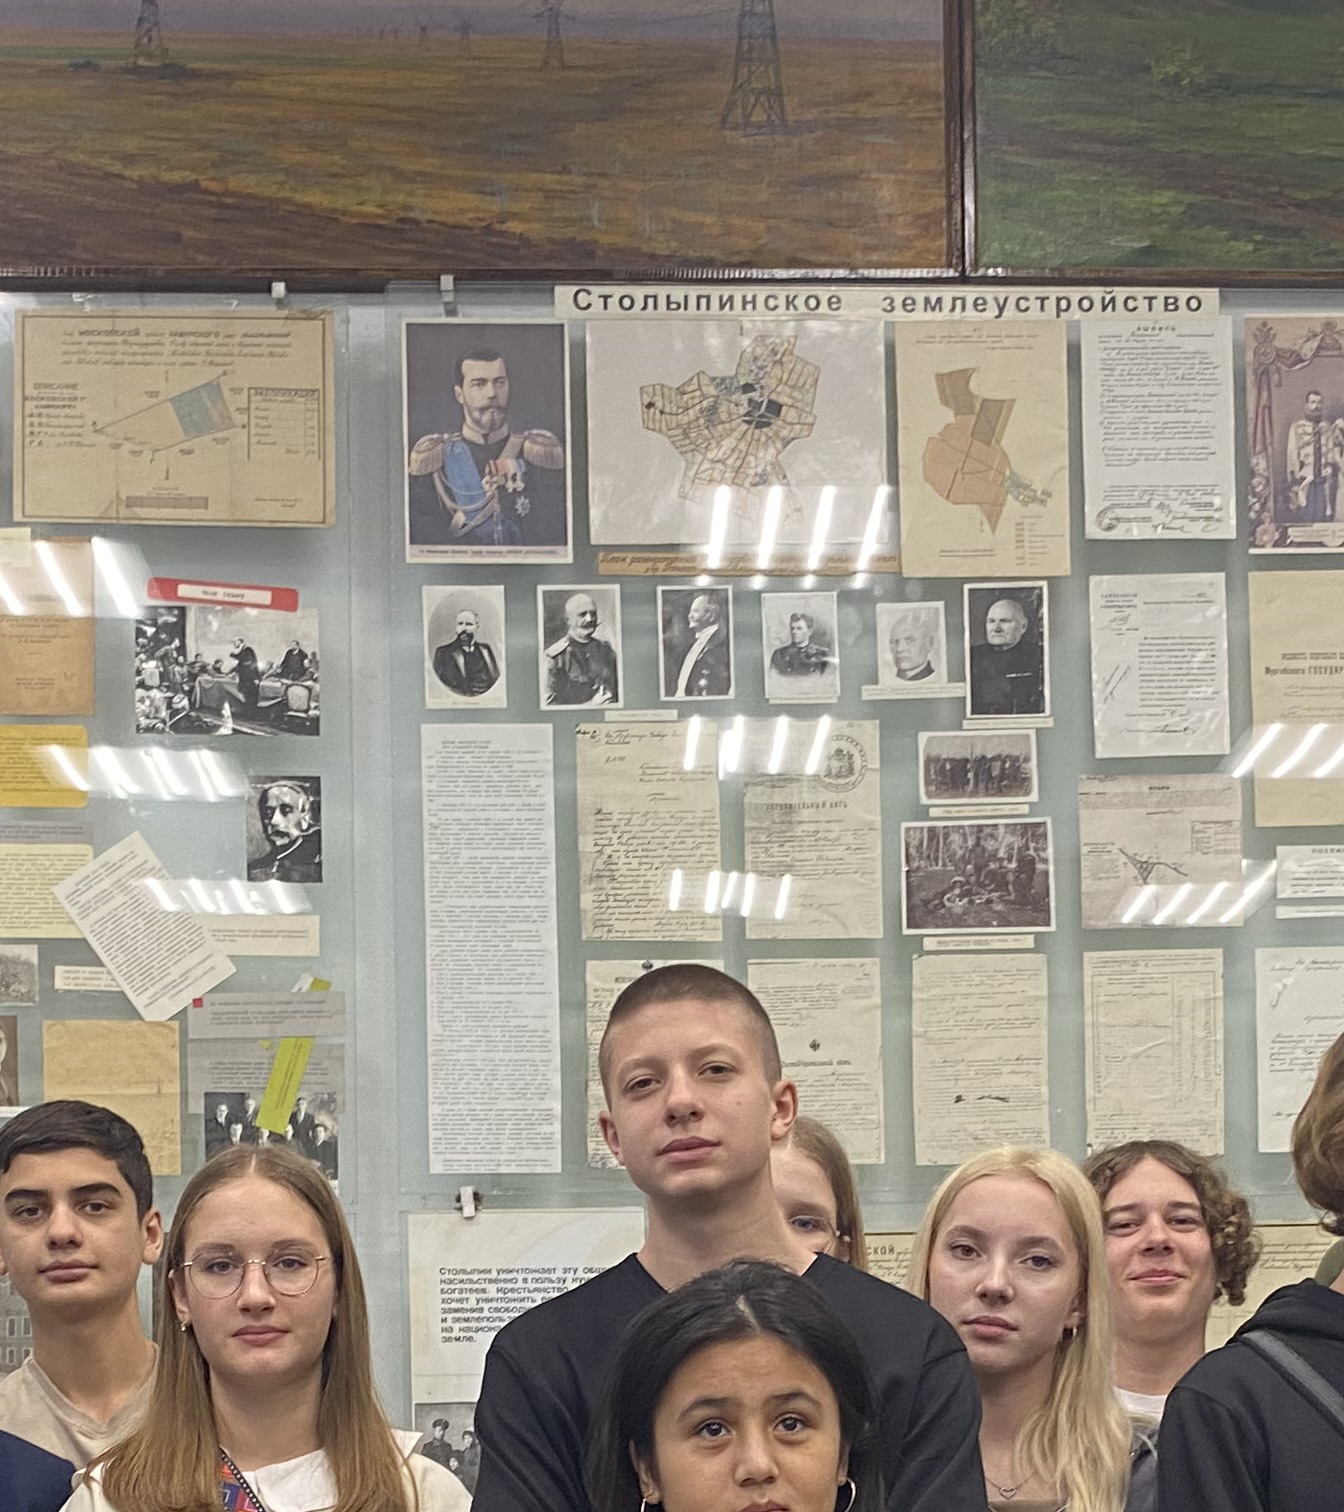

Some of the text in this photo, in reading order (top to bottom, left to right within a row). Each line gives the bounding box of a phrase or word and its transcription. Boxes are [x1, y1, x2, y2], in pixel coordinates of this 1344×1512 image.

[572, 288, 1203, 318] Столыпинское землеустройство
[439, 1266, 492, 1276] Столыпин
[496, 1267, 556, 1277] уничтожает
[562, 1268, 579, 1277] эту
[439, 1276, 518, 1285] насильственно
[531, 1277, 567, 1287] пользу
[440, 1286, 569, 1296] богатеев. Крестьянство
[441, 1296, 536, 1306] хочет уничтожить
[441, 1306, 484, 1315] заменив
[441, 1316, 447, 1324] и
[441, 1325, 453, 1334] на
[441, 1335, 477, 1344] земле.
